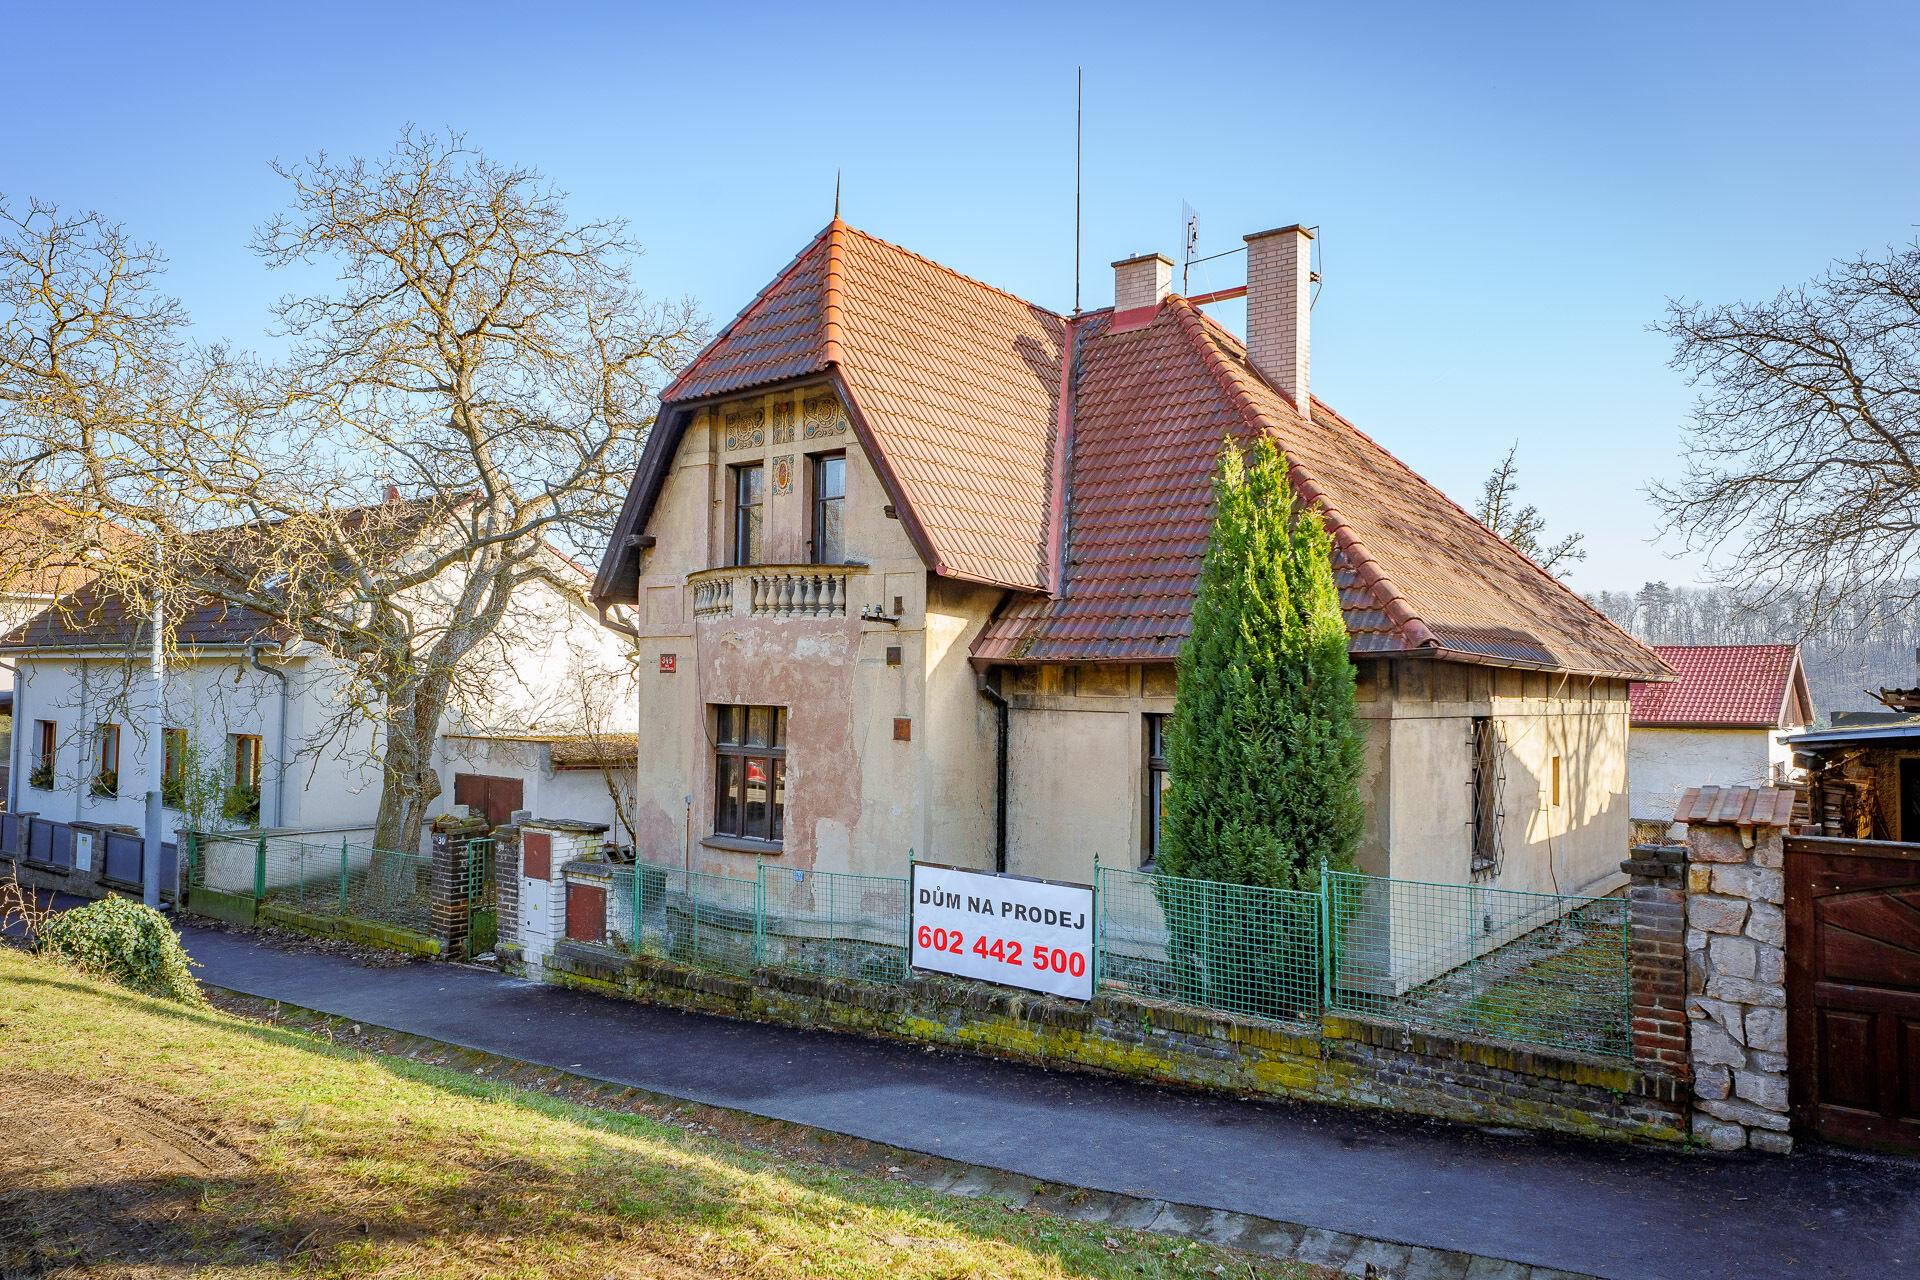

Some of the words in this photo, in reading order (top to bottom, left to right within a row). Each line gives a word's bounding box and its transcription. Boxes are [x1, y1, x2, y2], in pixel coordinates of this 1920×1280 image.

[919, 886, 961, 910] DŮM
[967, 896, 995, 916] NA
[1001, 901, 1085, 930] PRODEJ
[917, 925, 964, 955] 602
[972, 935, 1023, 966] 442
[1032, 945, 1086, 978] 500
